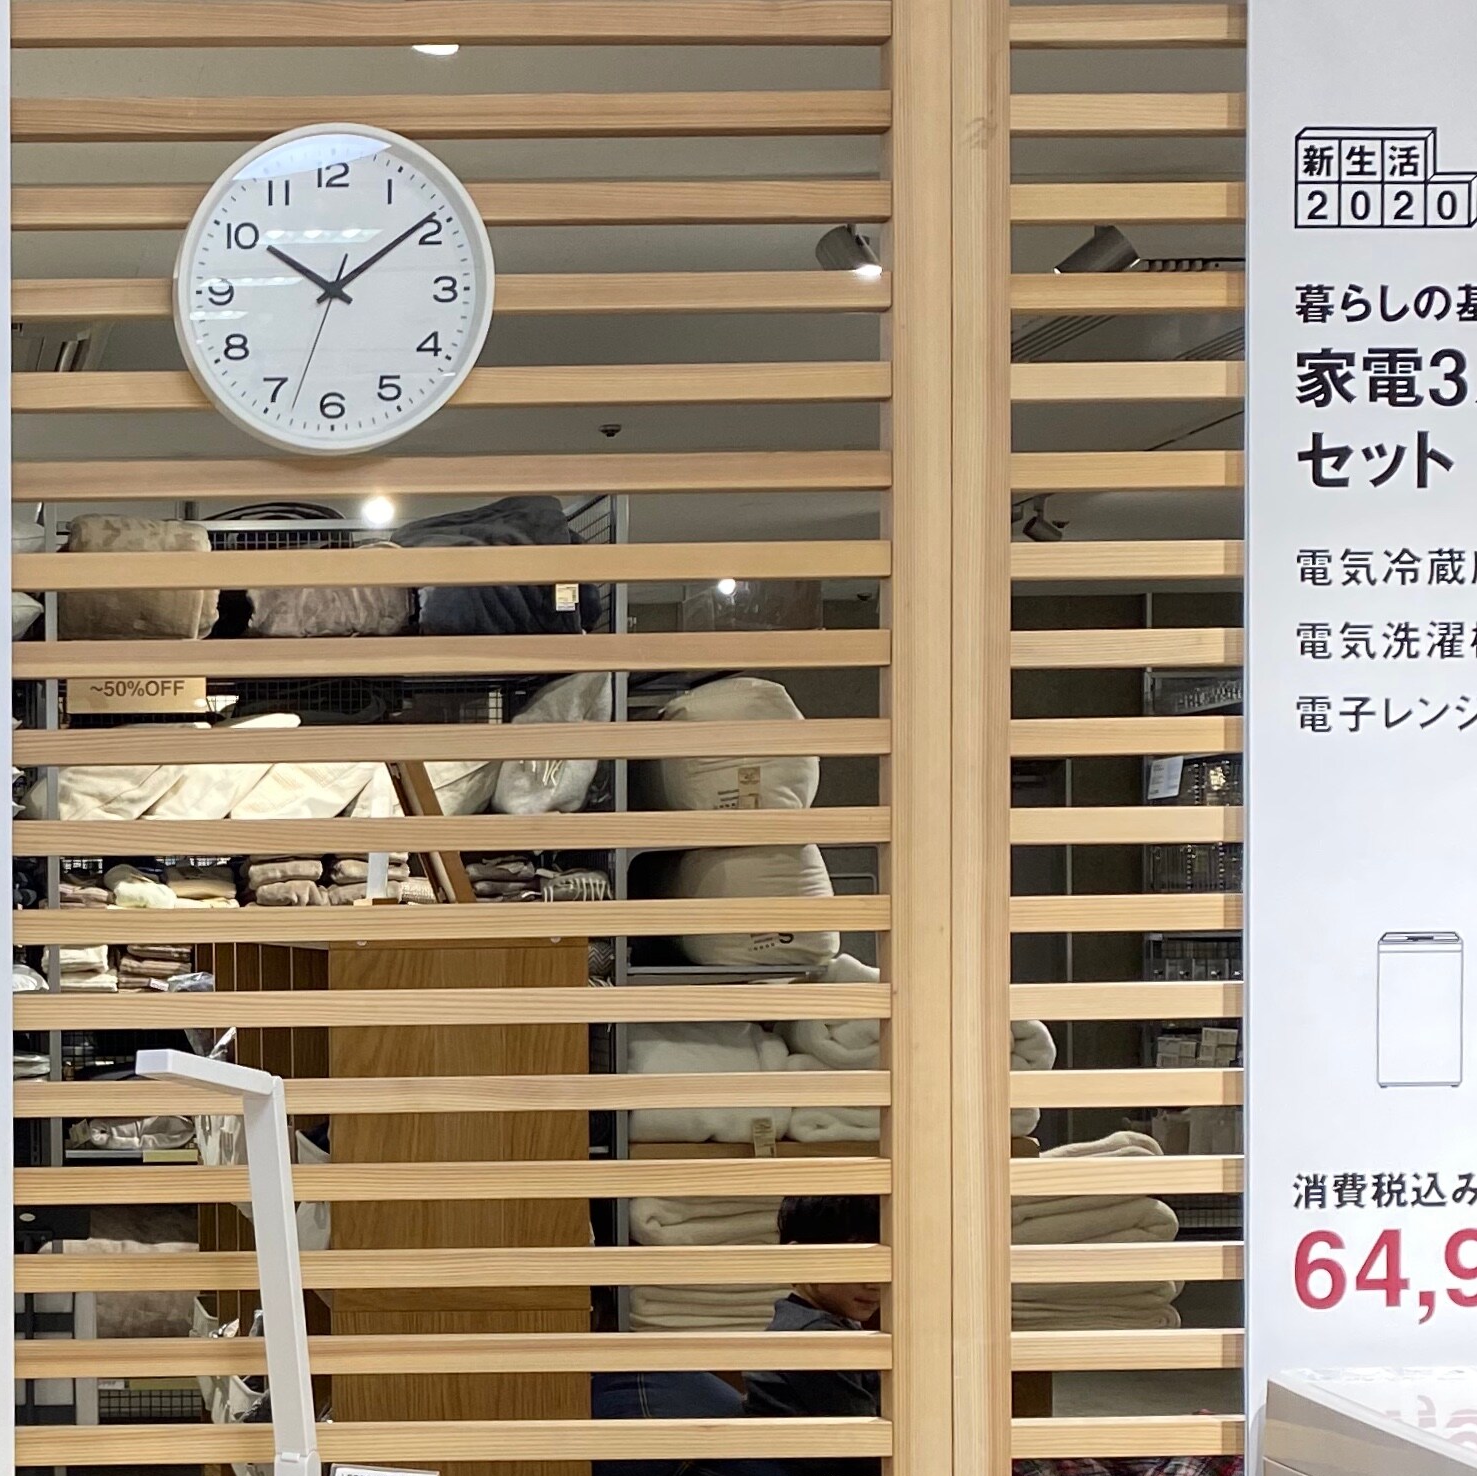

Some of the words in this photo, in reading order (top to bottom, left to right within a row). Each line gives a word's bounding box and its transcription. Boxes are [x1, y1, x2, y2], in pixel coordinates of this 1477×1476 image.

[317, 162, 350, 189] 12
[1303, 145, 1420, 178] 新生活
[268, 179, 290, 207] 11
[386, 178, 393, 205] 1
[1307, 190, 1457, 221] 2020
[226, 222, 260, 250] 10
[417, 218, 443, 246] 2
[207, 280, 235, 307] 9
[432, 275, 458, 303] 3
[223, 333, 250, 361] 8
[415, 330, 443, 357] 4
[263, 376, 289, 404] 7
[376, 374, 402, 402] 5
[1295, 347, 1477, 408] 家電3
[319, 391, 346, 420] 6
[1297, 430, 1454, 489] セット
[1296, 547, 1477, 586] 電気冷蔵
[1296, 621, 1477, 660] 電気洗濯
